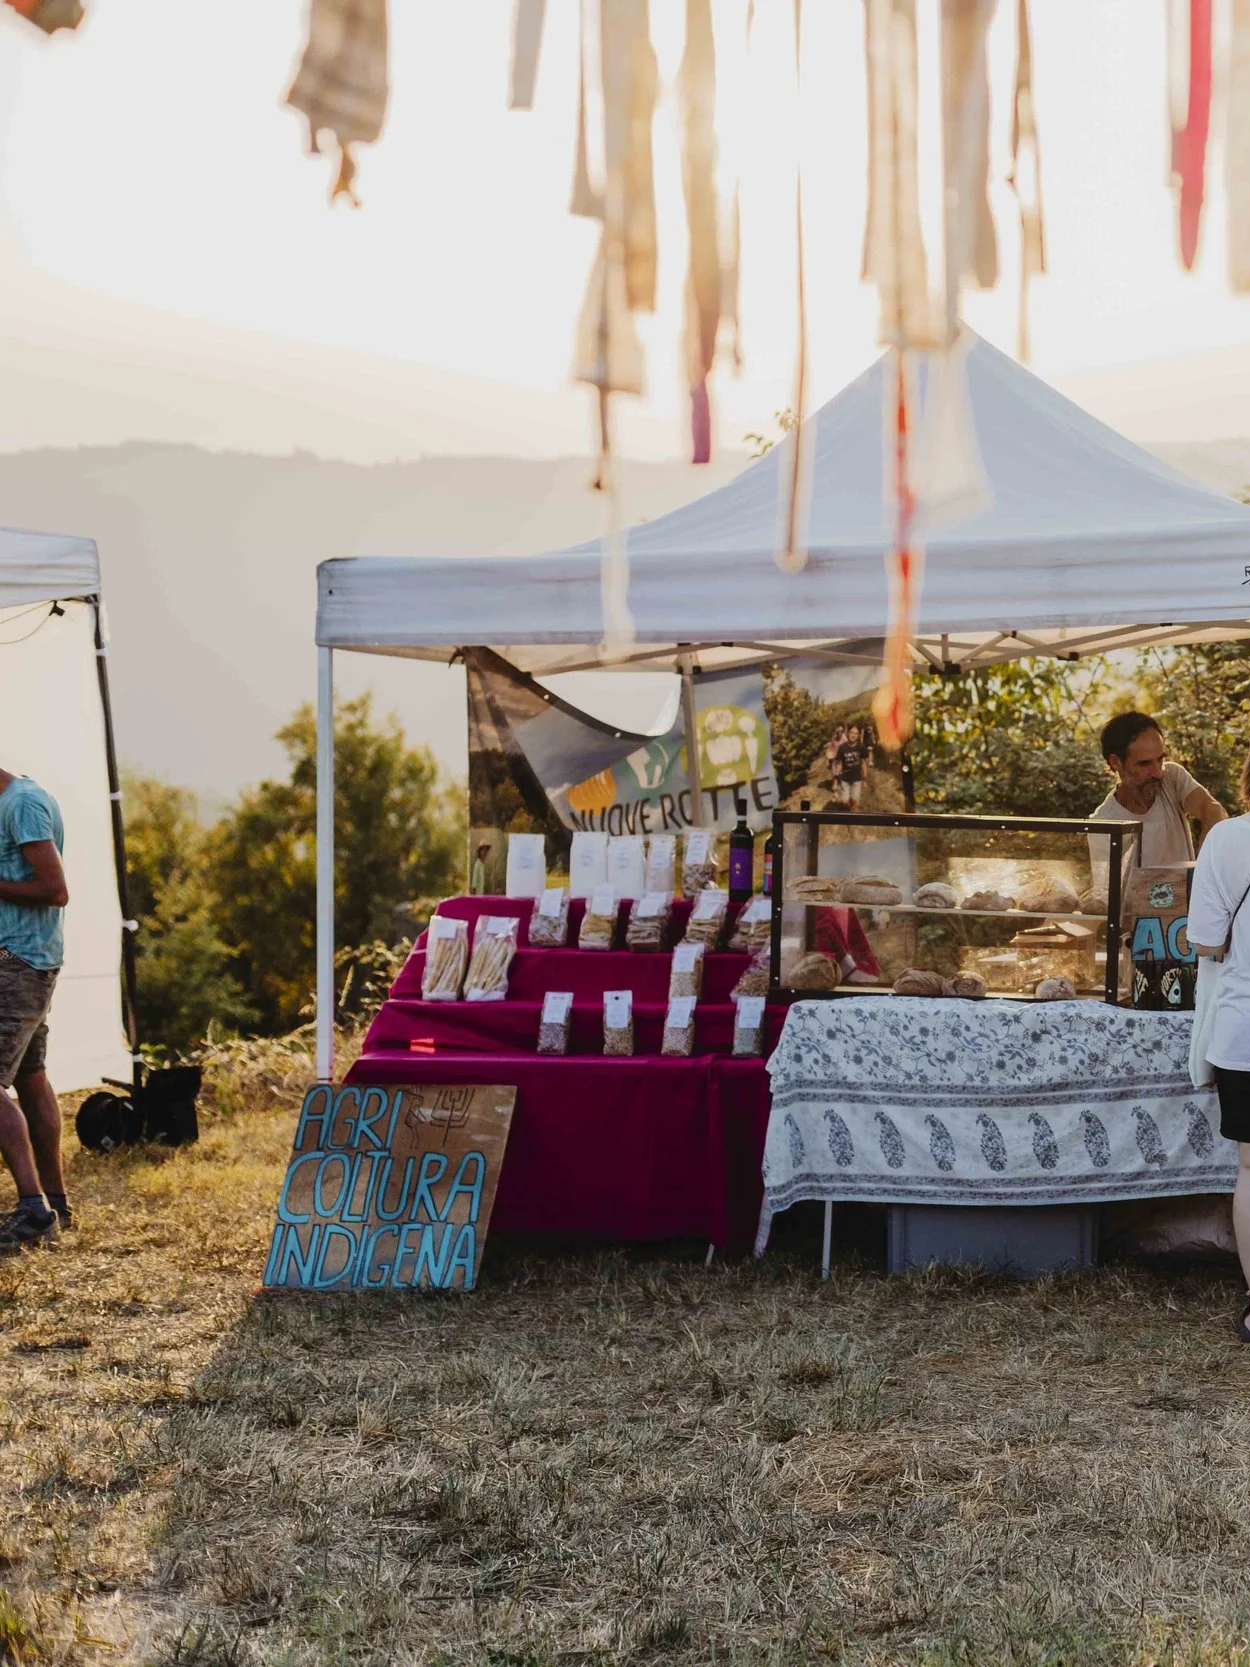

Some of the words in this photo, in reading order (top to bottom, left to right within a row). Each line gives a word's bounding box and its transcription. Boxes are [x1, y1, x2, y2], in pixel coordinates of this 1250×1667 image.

[570, 797, 653, 837] NUOVE
[659, 776, 774, 830] ROTTE
[294, 1084, 403, 1150] AGRI
[277, 1151, 487, 1224] COLTURA
[263, 1222, 477, 1290] INDIGENA
